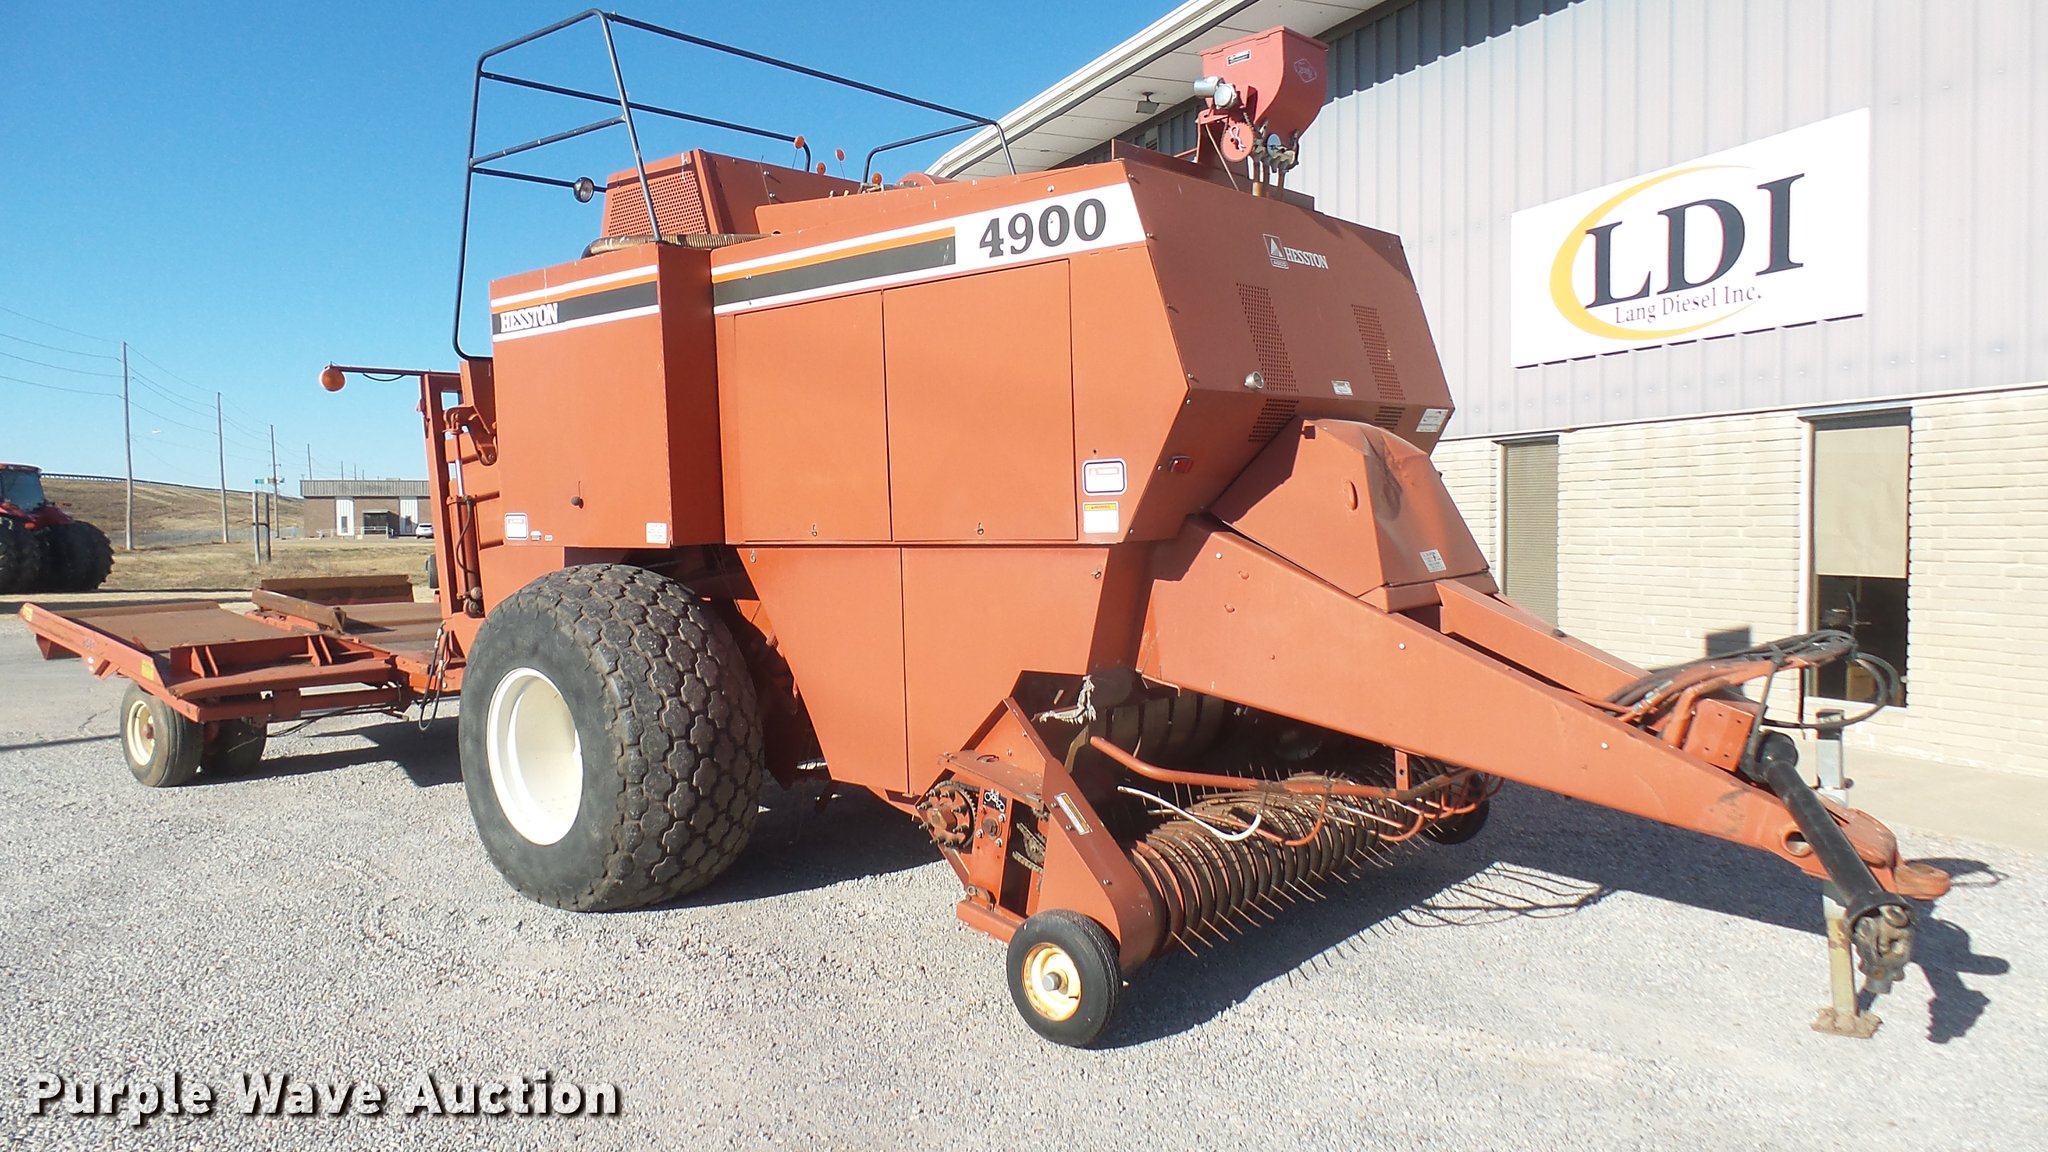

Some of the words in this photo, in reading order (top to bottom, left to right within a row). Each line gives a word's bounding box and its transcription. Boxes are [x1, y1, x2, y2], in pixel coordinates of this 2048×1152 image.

[979, 198, 1107, 259] 4900
[1585, 172, 1805, 310] LDI
[1283, 246, 1329, 270] HESSTON
[500, 302, 559, 333] HESSTON
[1615, 306, 1656, 323] Lang
[1662, 287, 1717, 316] Diesel
[1725, 285, 1762, 304] Inc.
